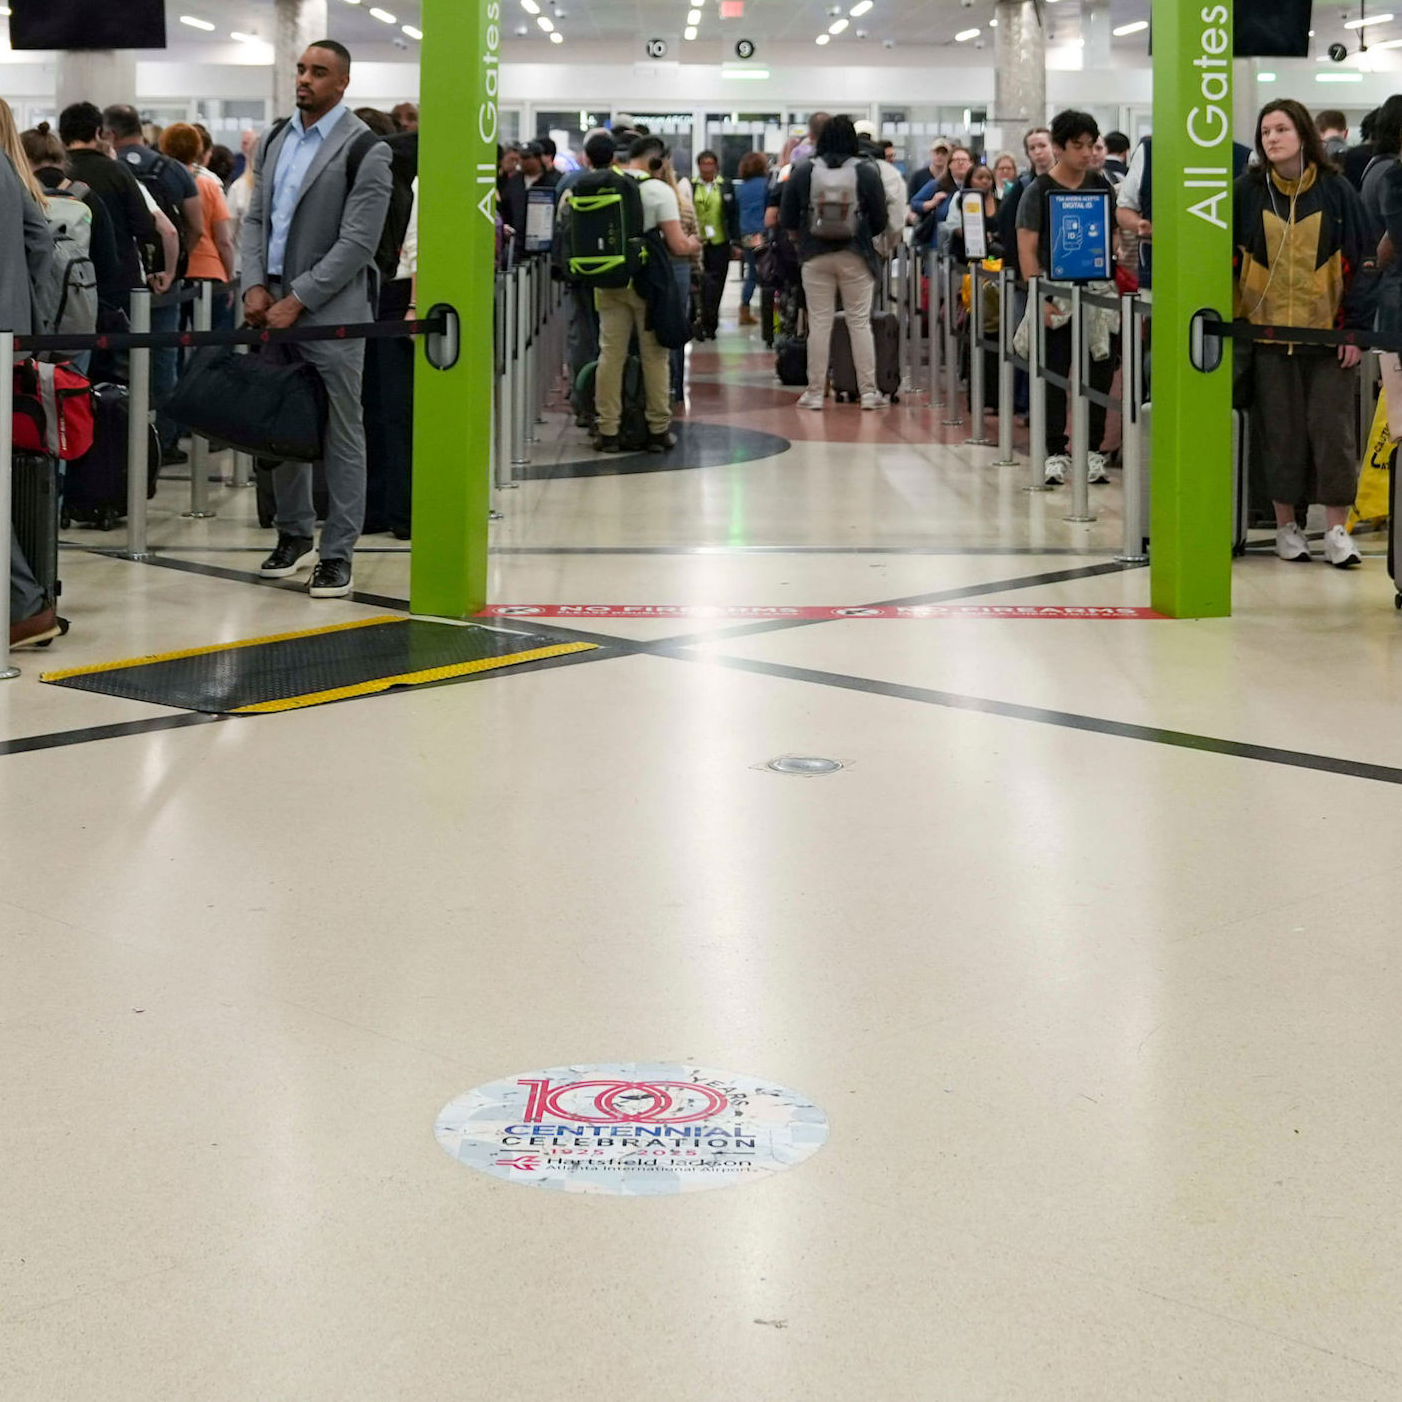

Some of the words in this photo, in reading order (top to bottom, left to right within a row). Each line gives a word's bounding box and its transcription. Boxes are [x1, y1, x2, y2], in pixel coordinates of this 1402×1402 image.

[646, 40, 667, 58] 10
[479, 2, 500, 144] Gates
[1186, 5, 1229, 148] Gates
[477, 164, 496, 224] All
[1184, 167, 1228, 229] All
[517, 1078, 728, 1124] 100
[502, 1136, 756, 1148] CELEBRATION
[504, 1124, 757, 1138] CENTENNIAL
[550, 1148, 605, 1156] 1925
[639, 1148, 698, 1156] 2025
